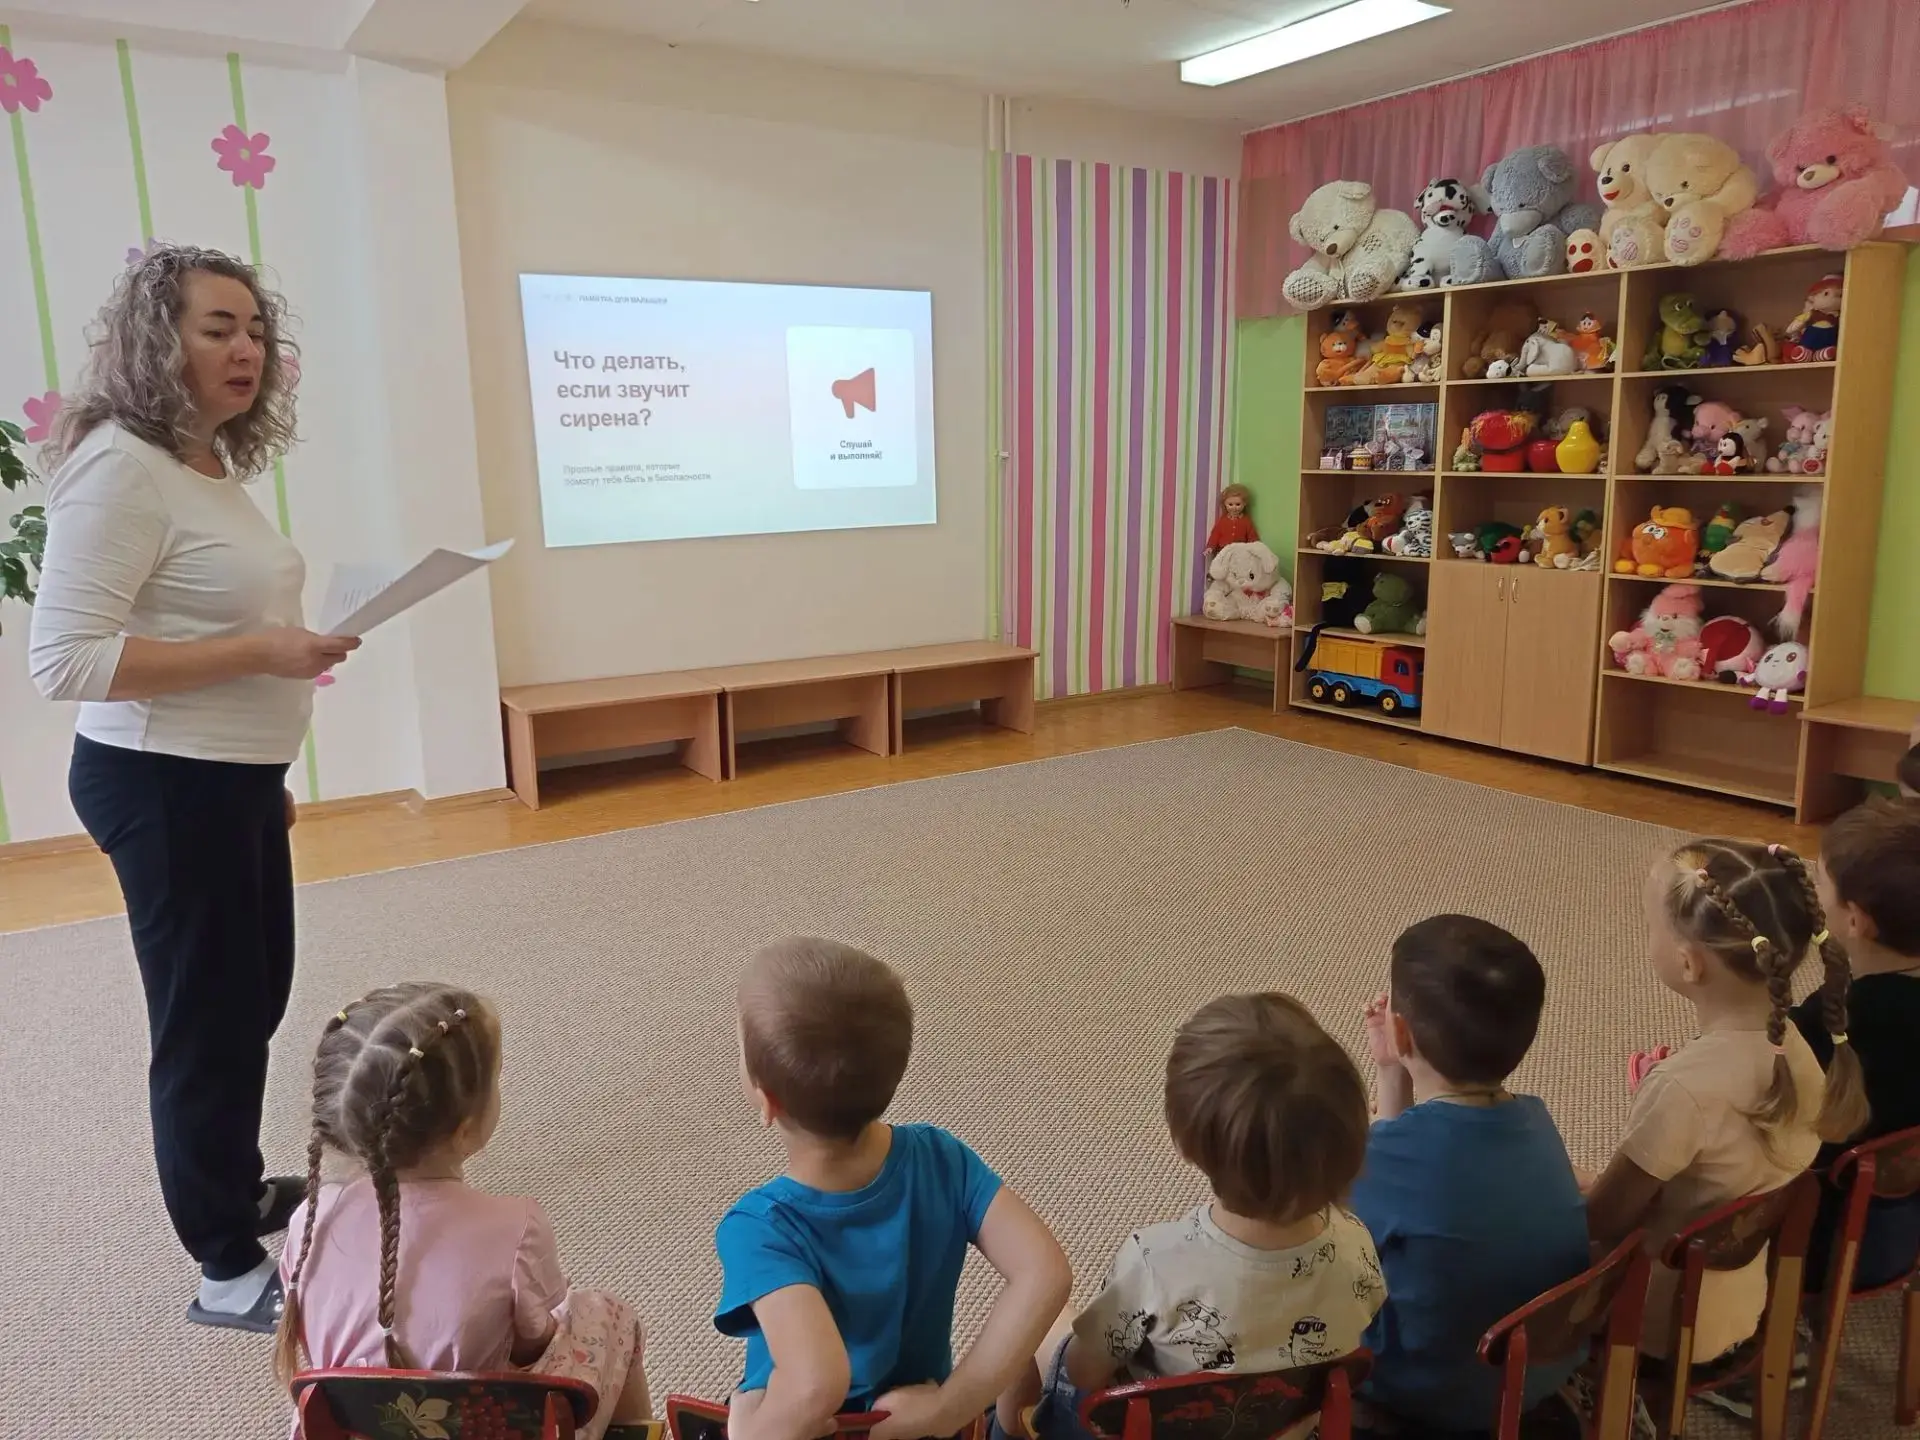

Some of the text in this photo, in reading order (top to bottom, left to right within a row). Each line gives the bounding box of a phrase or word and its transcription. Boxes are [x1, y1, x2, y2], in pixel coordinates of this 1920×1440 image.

[554, 350, 685, 373] Что делать,
[557, 384, 690, 402] если звучит
[560, 408, 651, 431] сирена?
[840, 439, 872, 450] Слушай
[838, 450, 882, 460] выполняй!
[563, 465, 602, 475] Простые
[646, 463, 680, 472] которые
[564, 477, 599, 487] помогут
[602, 476, 622, 485] тебе
[624, 474, 646, 483] быть
